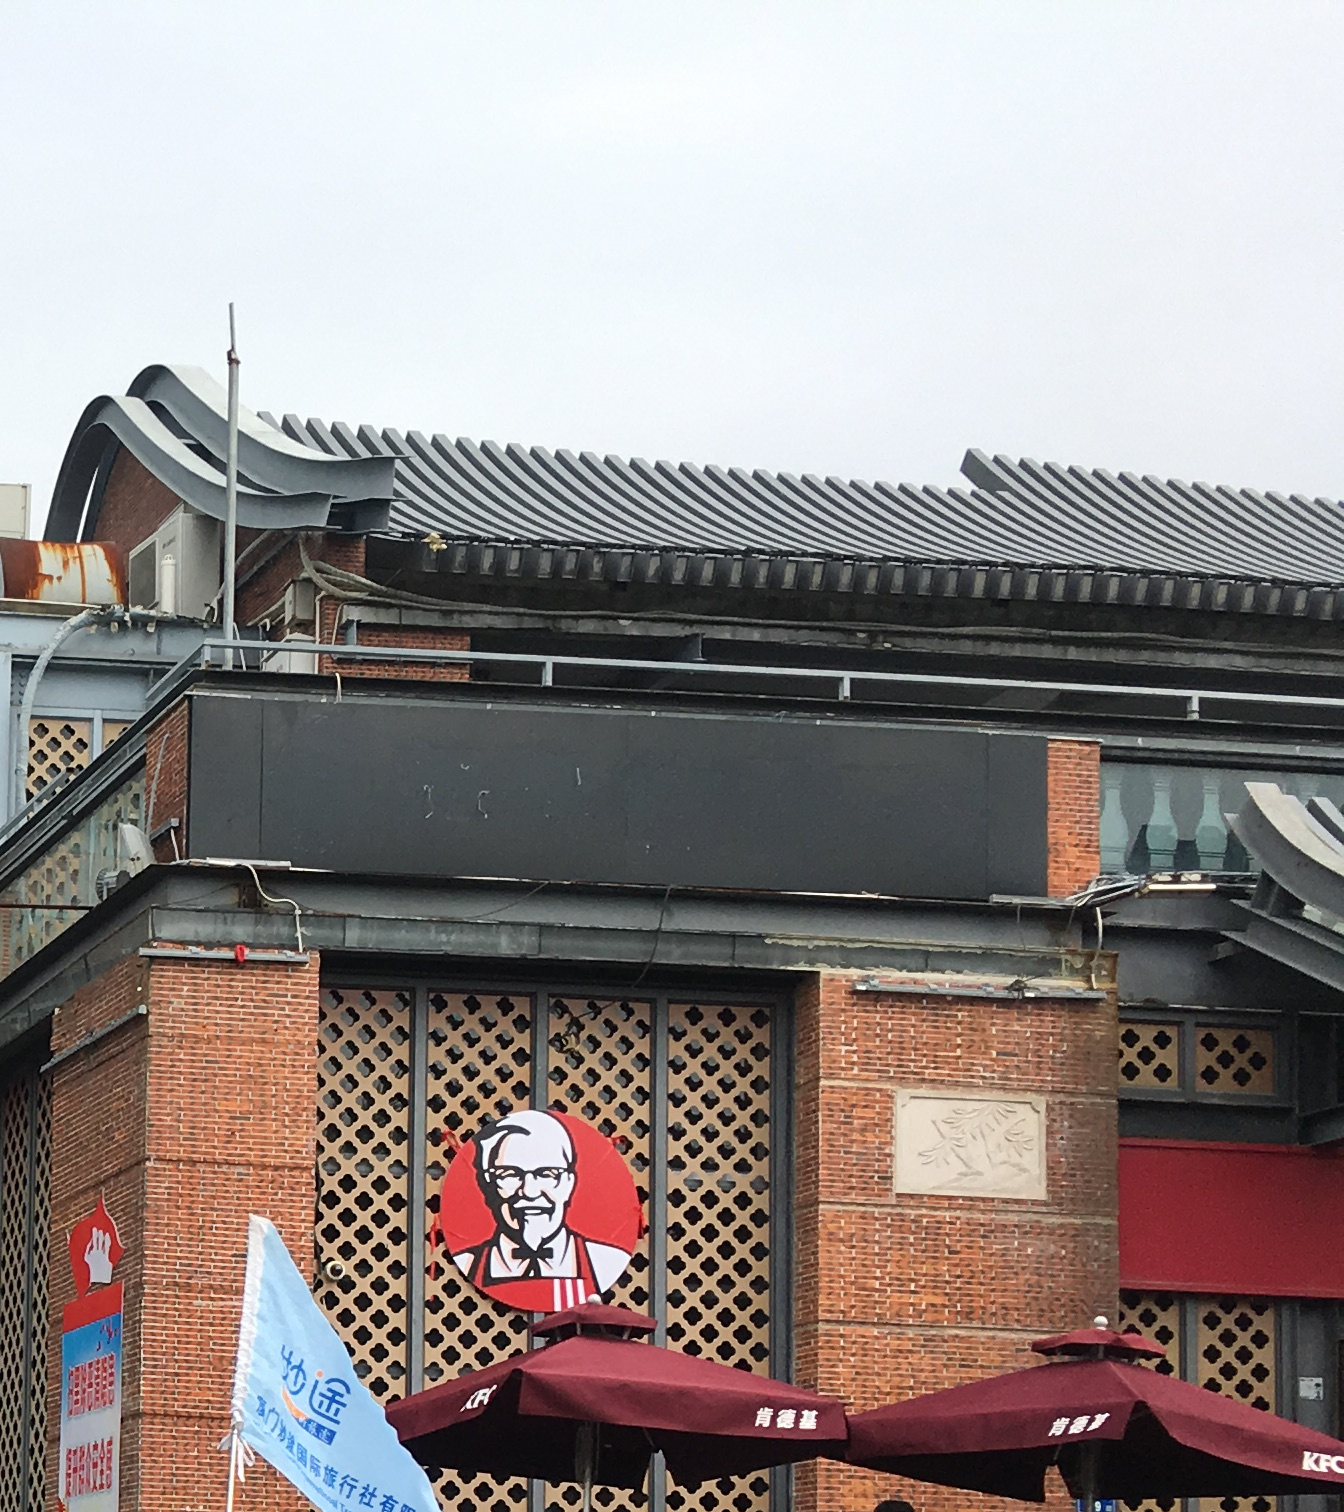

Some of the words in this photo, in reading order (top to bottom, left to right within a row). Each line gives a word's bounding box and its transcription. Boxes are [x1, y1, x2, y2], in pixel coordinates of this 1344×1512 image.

[460, 1385, 498, 1412] KFC
[754, 1406, 819, 1430] 肯德基
[1301, 1450, 1344, 1475] KFC
